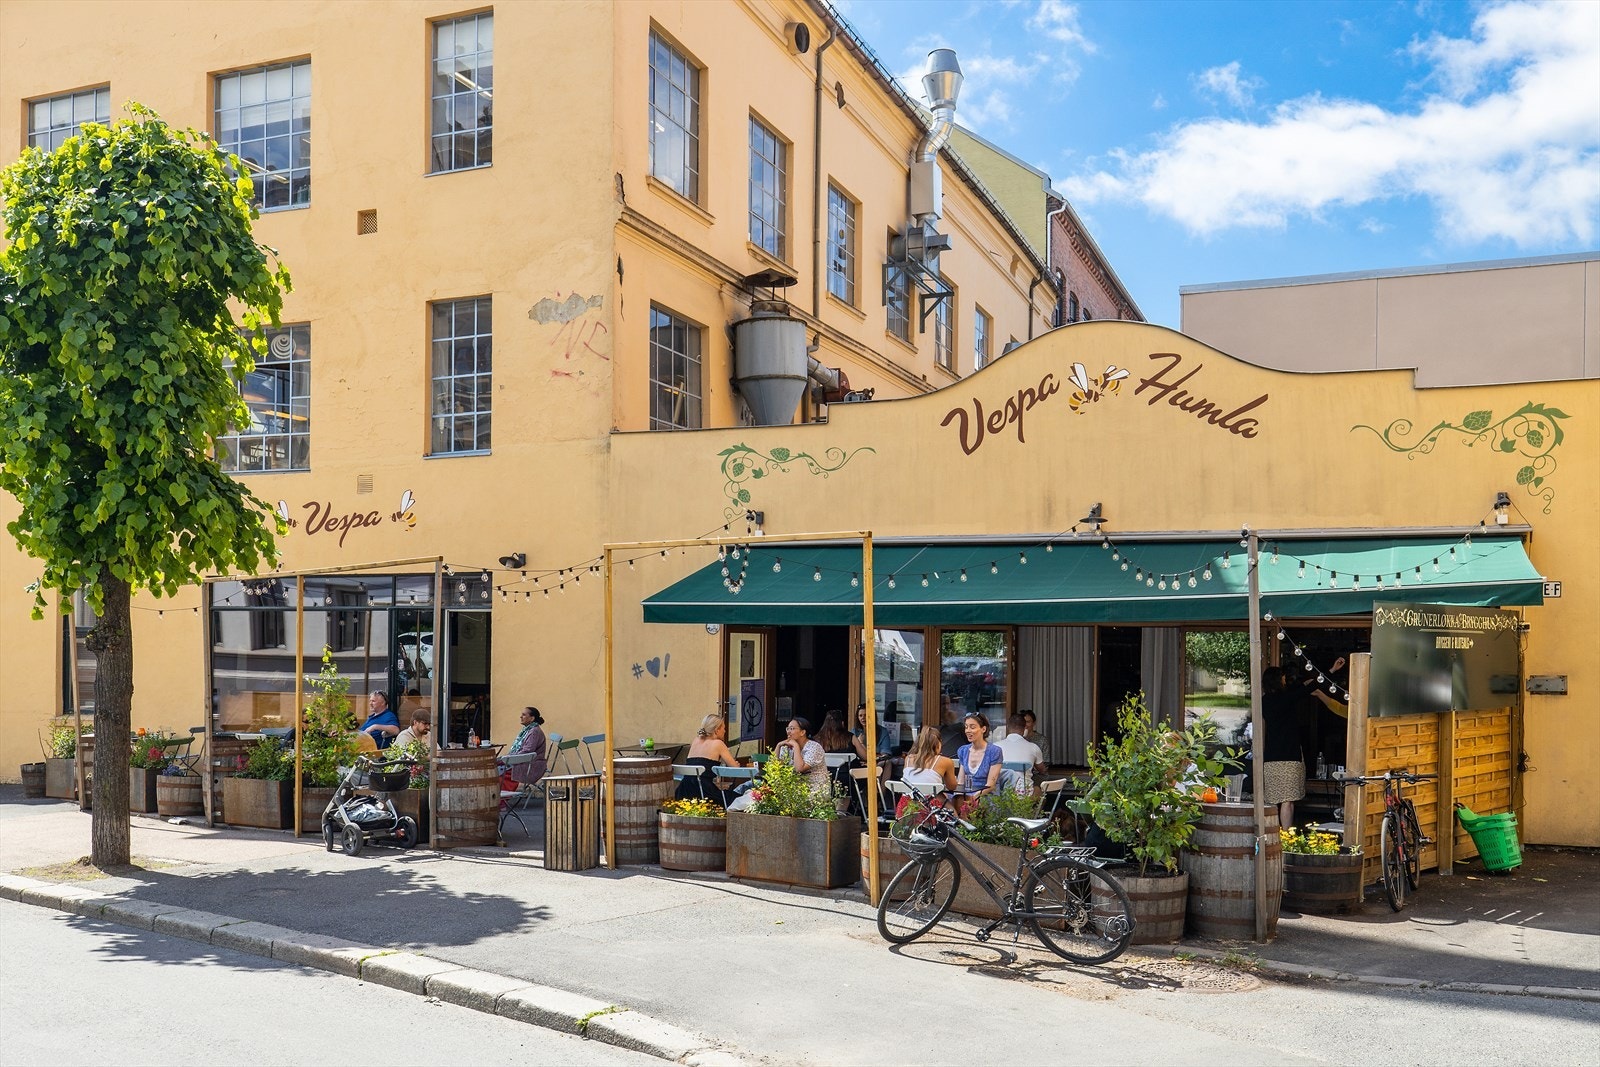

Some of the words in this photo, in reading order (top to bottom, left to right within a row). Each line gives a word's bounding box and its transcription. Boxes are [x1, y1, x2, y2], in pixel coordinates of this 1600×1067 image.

[940, 373, 1060, 455] Vespa
[1134, 353, 1269, 438] Humla
[302, 501, 382, 548] Vespa
